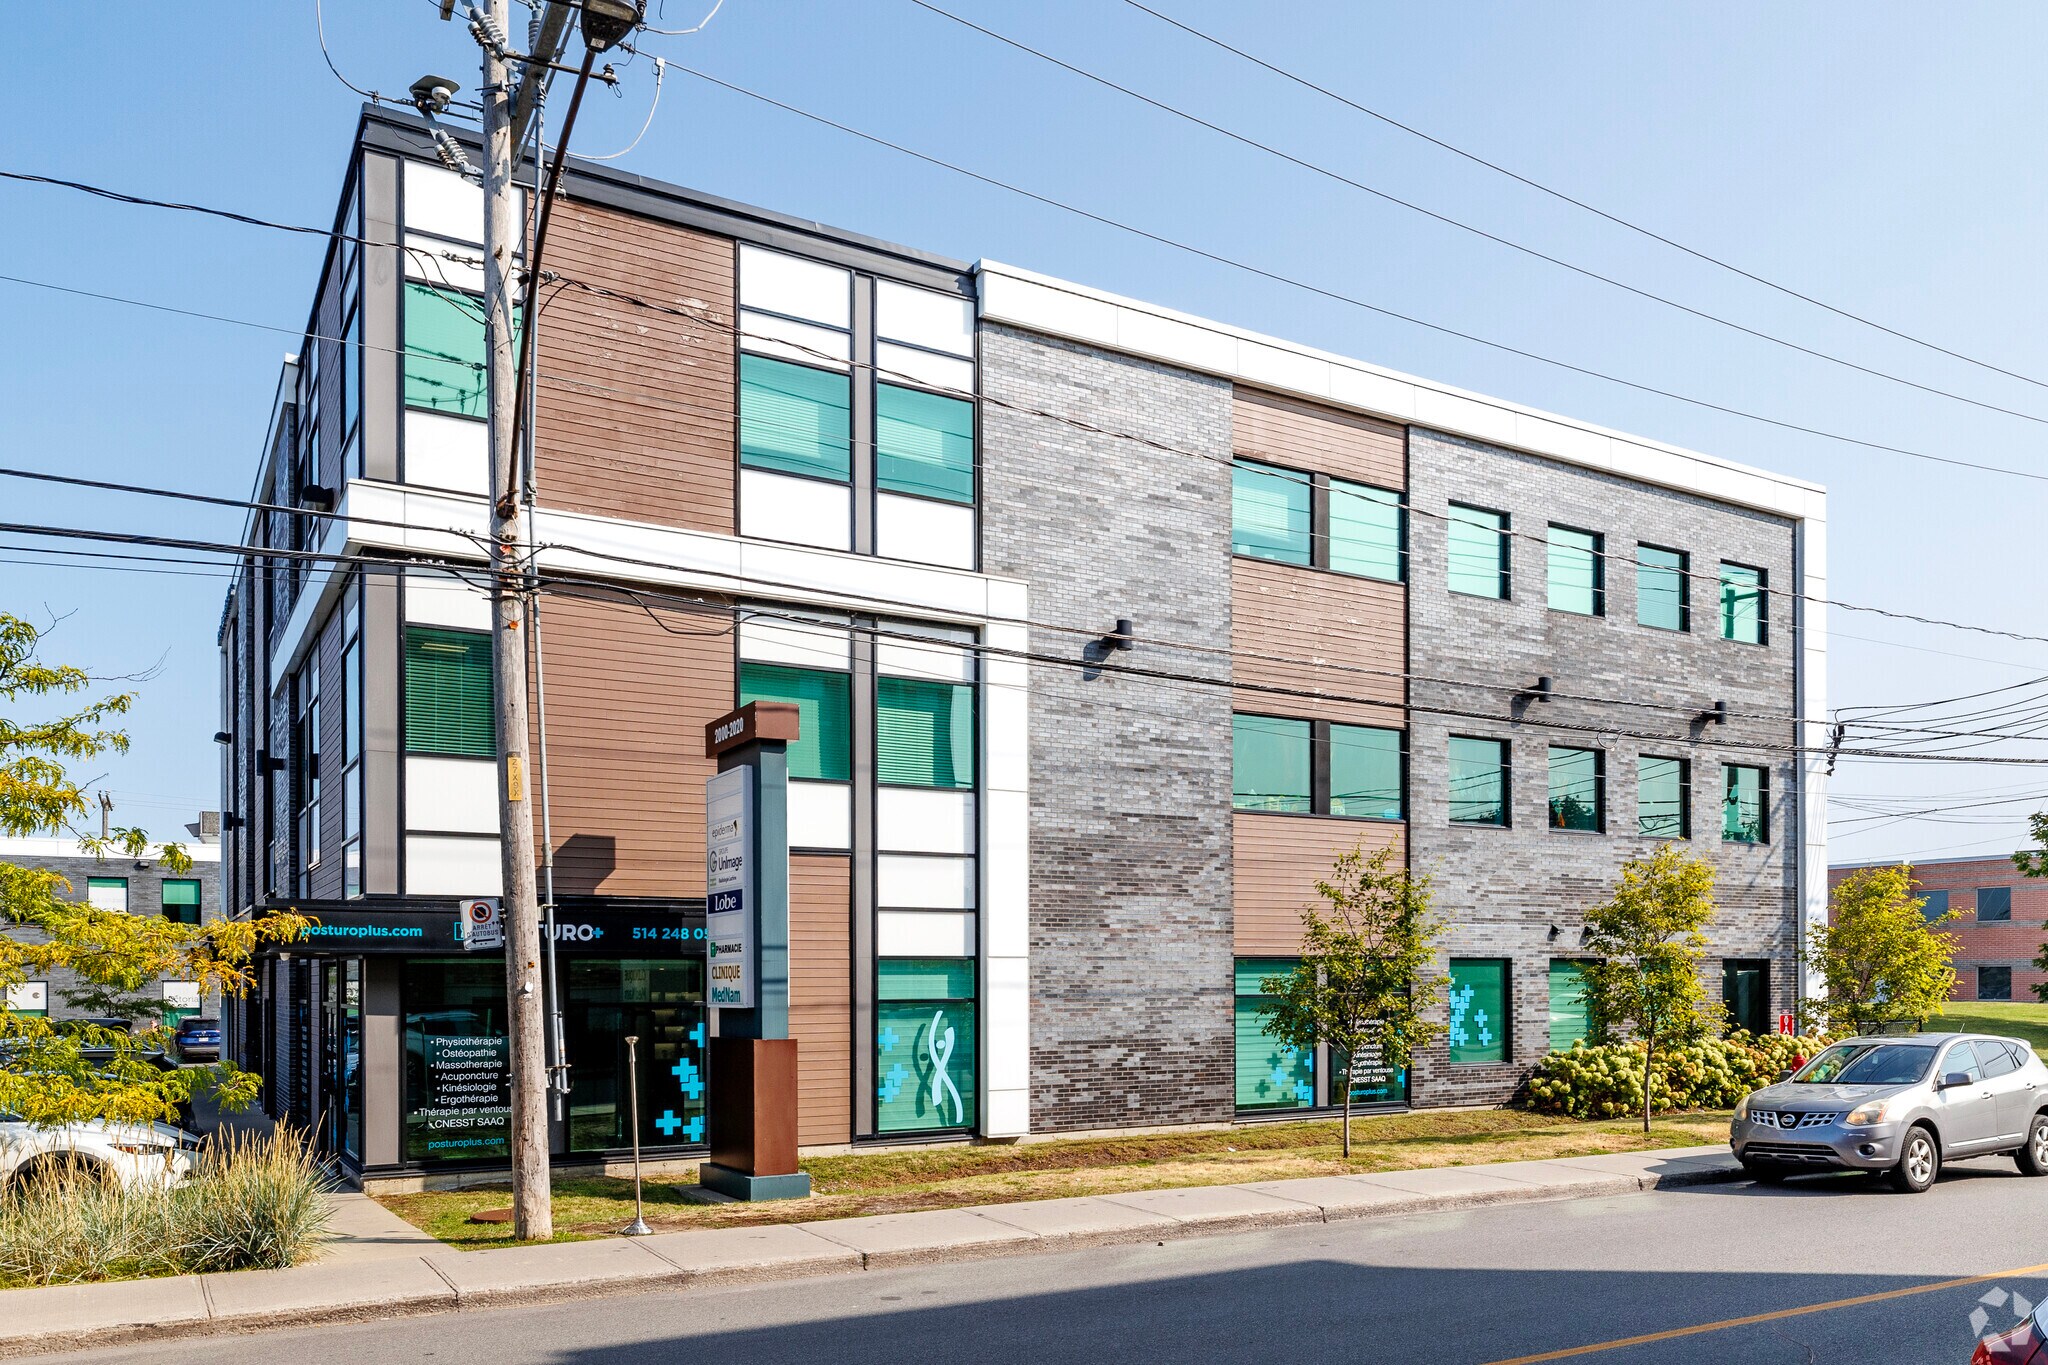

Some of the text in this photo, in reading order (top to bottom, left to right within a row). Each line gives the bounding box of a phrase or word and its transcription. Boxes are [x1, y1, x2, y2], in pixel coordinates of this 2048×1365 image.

[715, 895, 737, 911] Lobe
[301, 924, 423, 938] posturoplus.com
[632, 927, 657, 939] 514
[662, 927, 689, 940] 248
[716, 943, 742, 955] PHARMACIE
[712, 965, 741, 983] CLINIQUE
[711, 986, 741, 1003] MedNam
[436, 1037, 502, 1048] Physiothérapie
[442, 1048, 497, 1058] Ostéopathie
[440, 1072, 499, 1082] Acuponcture
[442, 1083, 497, 1093] Kinésiologie
[440, 1094, 499, 1105] Ergothérapie
[419, 1105, 513, 1117] Thérapie par ventous
[435, 1116, 505, 1129] CNESST SAAQ
[428, 1137, 504, 1150] posturoplus.com
